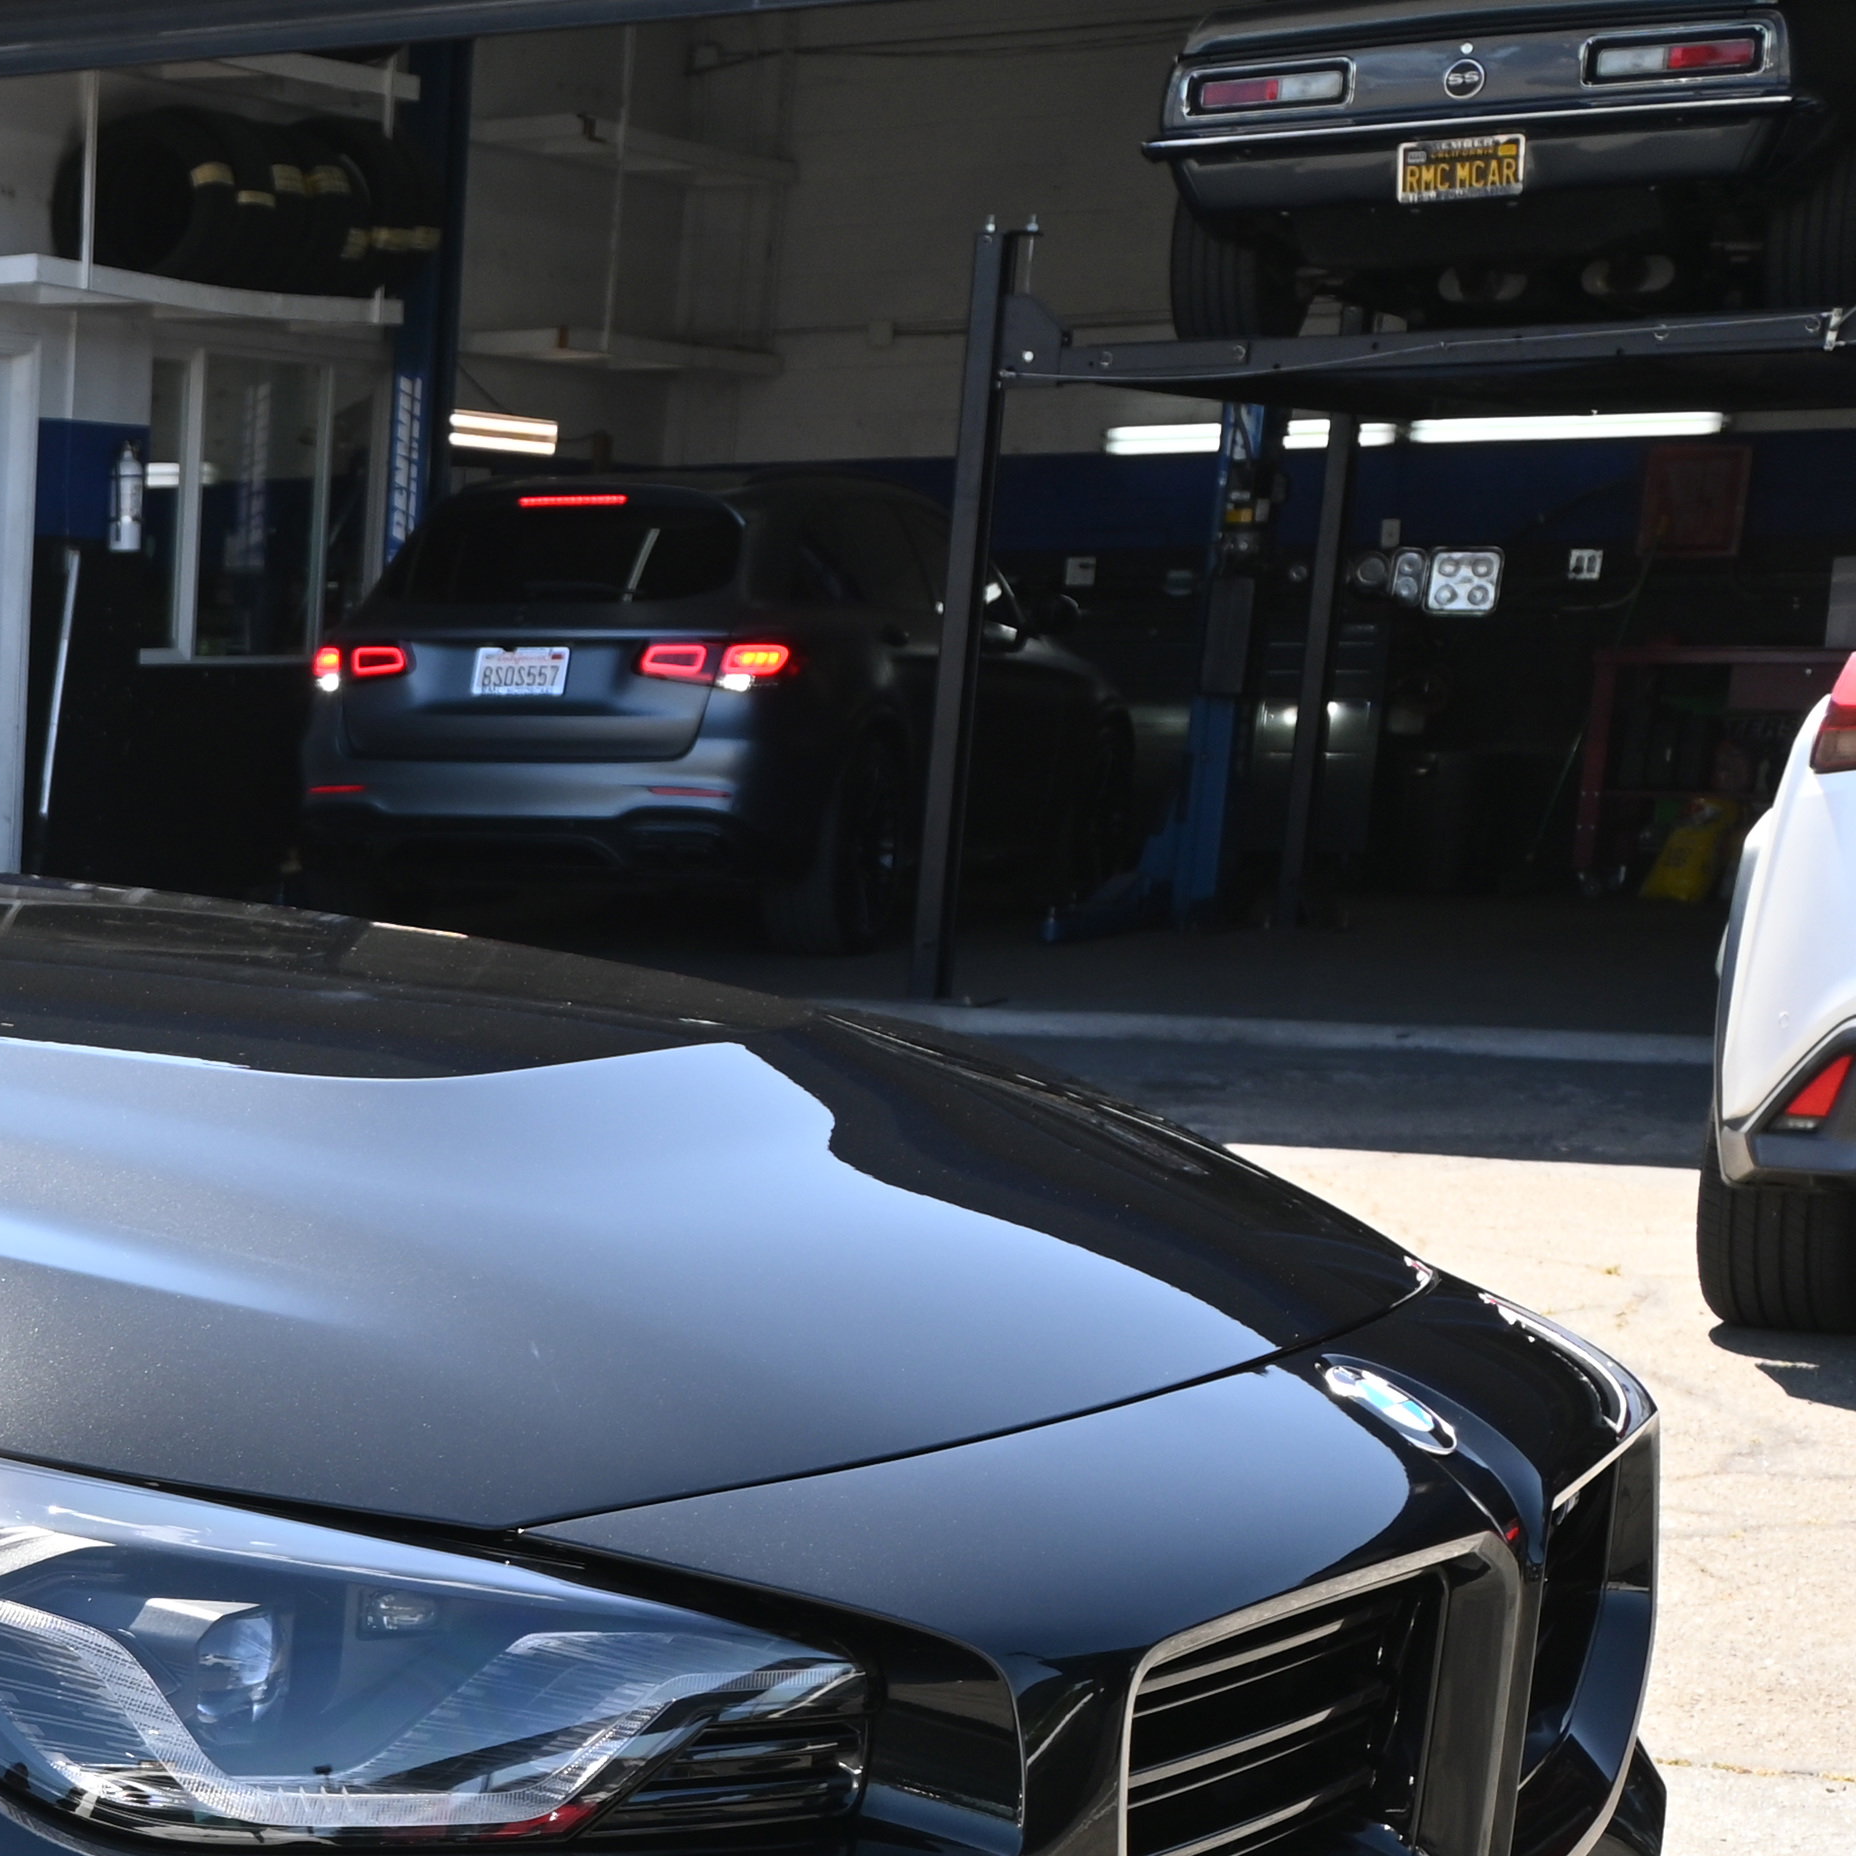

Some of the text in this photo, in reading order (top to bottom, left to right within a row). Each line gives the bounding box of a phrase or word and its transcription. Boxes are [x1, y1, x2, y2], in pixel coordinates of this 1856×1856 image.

[1447, 70, 1480, 85] SS
[1405, 158, 1517, 192] RMC MCAR
